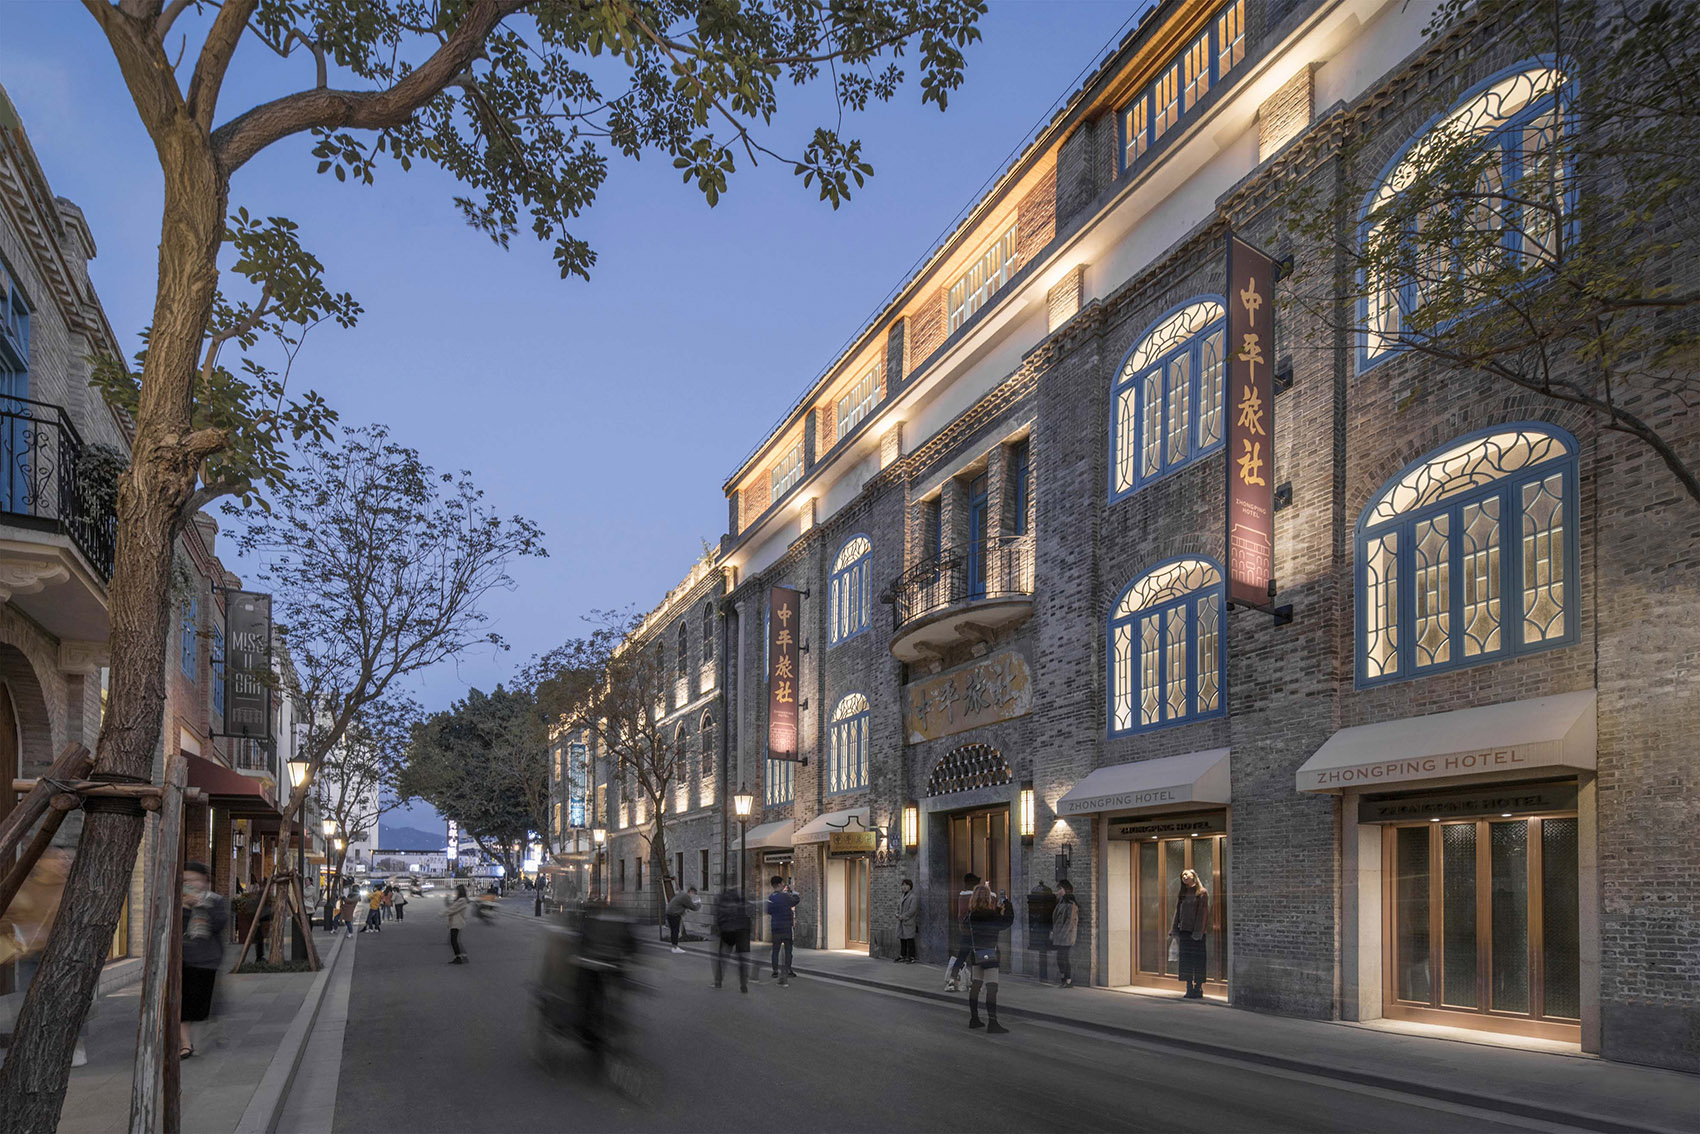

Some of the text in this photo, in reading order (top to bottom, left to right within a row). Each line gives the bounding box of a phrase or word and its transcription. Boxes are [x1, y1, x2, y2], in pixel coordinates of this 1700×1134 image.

[1236, 276, 1266, 487] 中平旅社
[1242, 507, 1260, 519] HOTEL
[774, 602, 794, 704] 中平旅社
[1317, 750, 1525, 784] ZHONGPING HOTEL
[1069, 791, 1176, 812] ZHONGPING HOTEL
